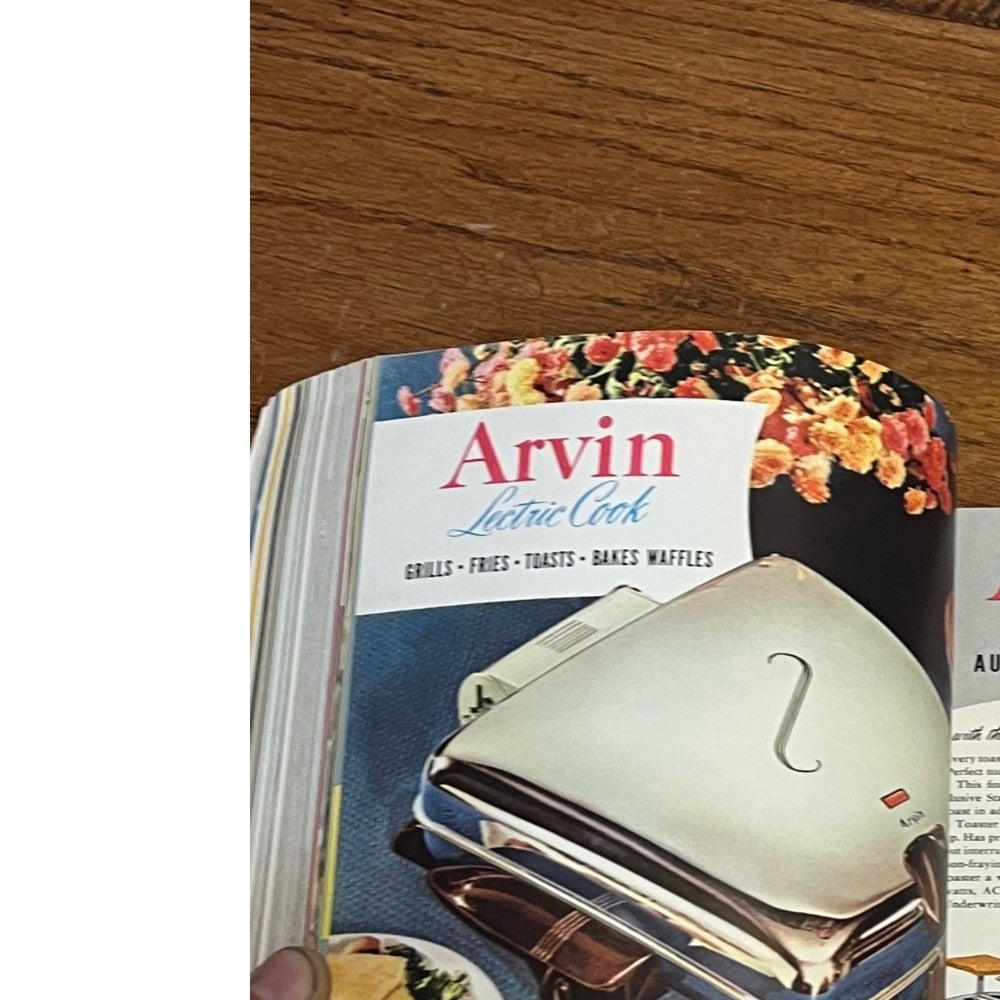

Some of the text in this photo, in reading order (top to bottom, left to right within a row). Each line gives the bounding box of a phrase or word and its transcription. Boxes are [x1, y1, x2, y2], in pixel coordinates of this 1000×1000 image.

[439, 415, 680, 490] Arvin
[448, 479, 657, 538] Lectric Cook
[404, 548, 714, 580] GRILLS FRIES TOASTS BAKES WAFFLES
[950, 756, 976, 764] very
